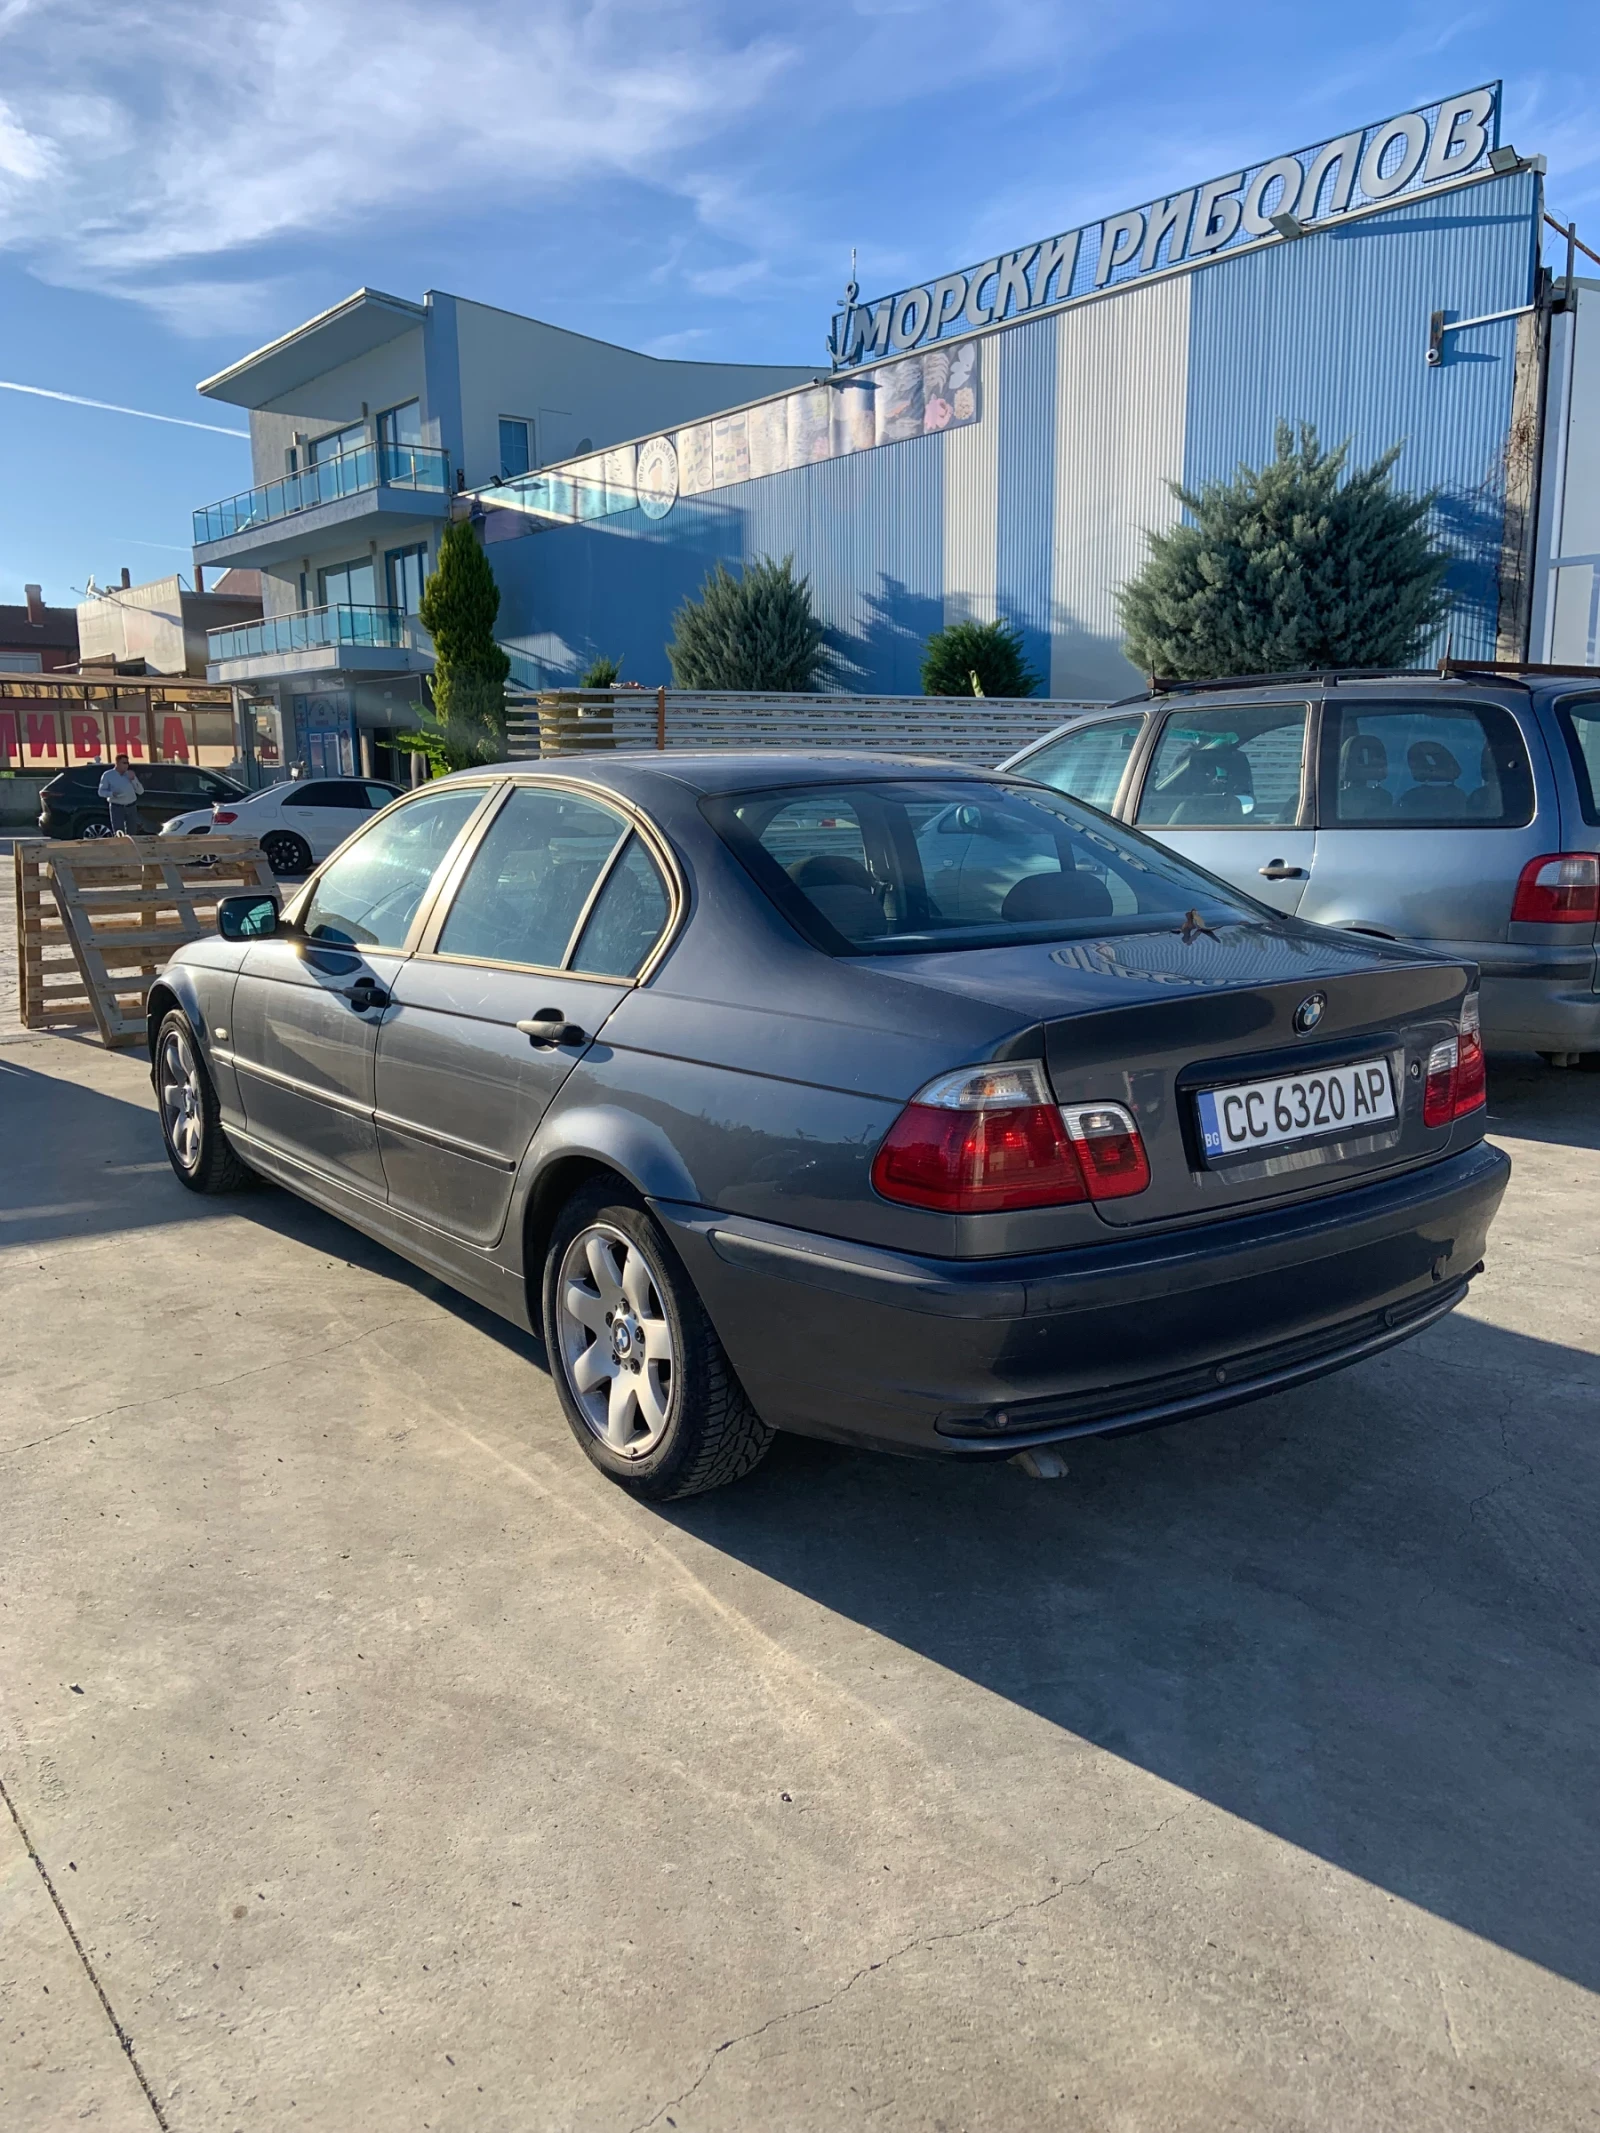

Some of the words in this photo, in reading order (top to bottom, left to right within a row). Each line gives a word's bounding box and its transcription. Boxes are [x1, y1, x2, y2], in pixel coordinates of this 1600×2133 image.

[853, 230, 1083, 364] МОРСКИ
[1094, 89, 1496, 288] РИБОЛОВ
[1303, 996, 1324, 1010] BMW
[1223, 1091, 1268, 1142] CC
[1274, 1076, 1345, 1132] 6320
[1353, 1068, 1385, 1117] AP
[1205, 1132, 1220, 1148] BG
